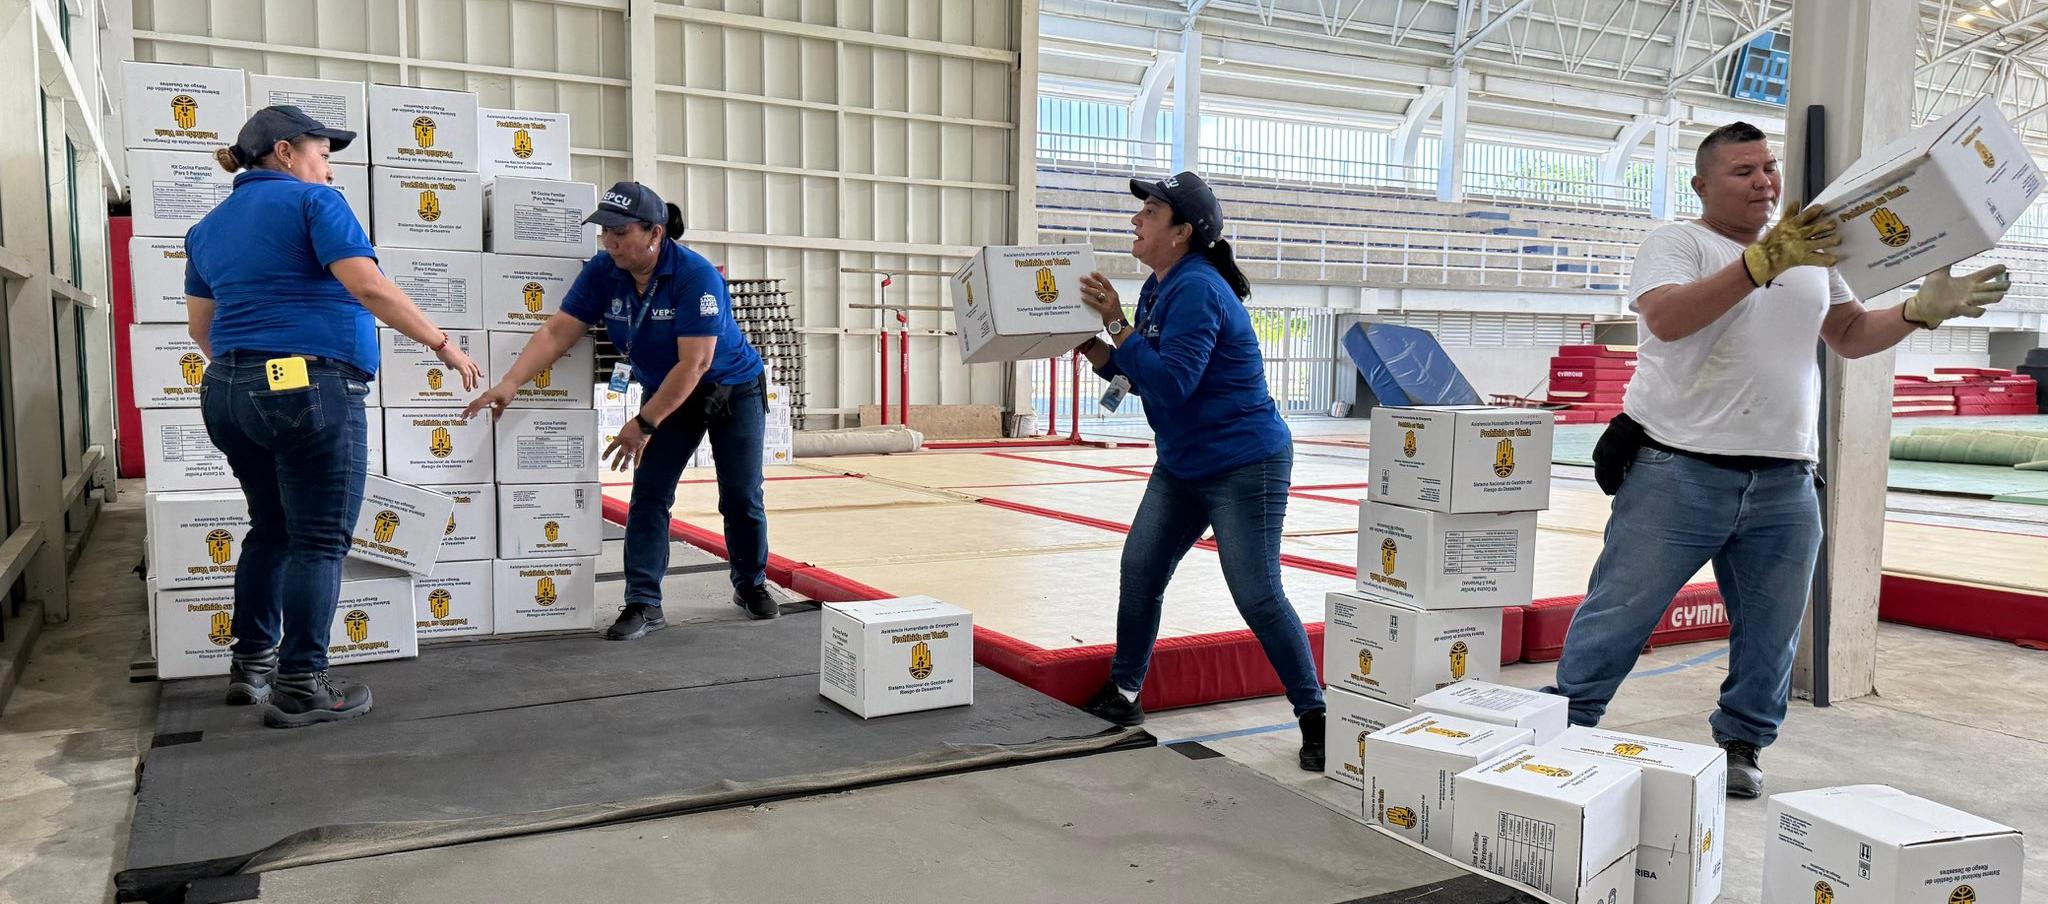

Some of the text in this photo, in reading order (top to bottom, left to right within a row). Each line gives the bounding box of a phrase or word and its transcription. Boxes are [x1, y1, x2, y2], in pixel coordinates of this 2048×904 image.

[604, 192, 631, 206] EPCU
[1480, 428, 1507, 438] Prohibido
[1515, 428, 1531, 437] Venta
[892, 633, 922, 644] Prohibido
[930, 630, 949, 640] Venta
[1480, 835, 1488, 864] Personas)
[1939, 867, 1964, 876] Desastres
[1972, 863, 1989, 872] Riesgo
[1635, 868, 1657, 880] RIBA
[1960, 872, 1982, 880] Nacional
